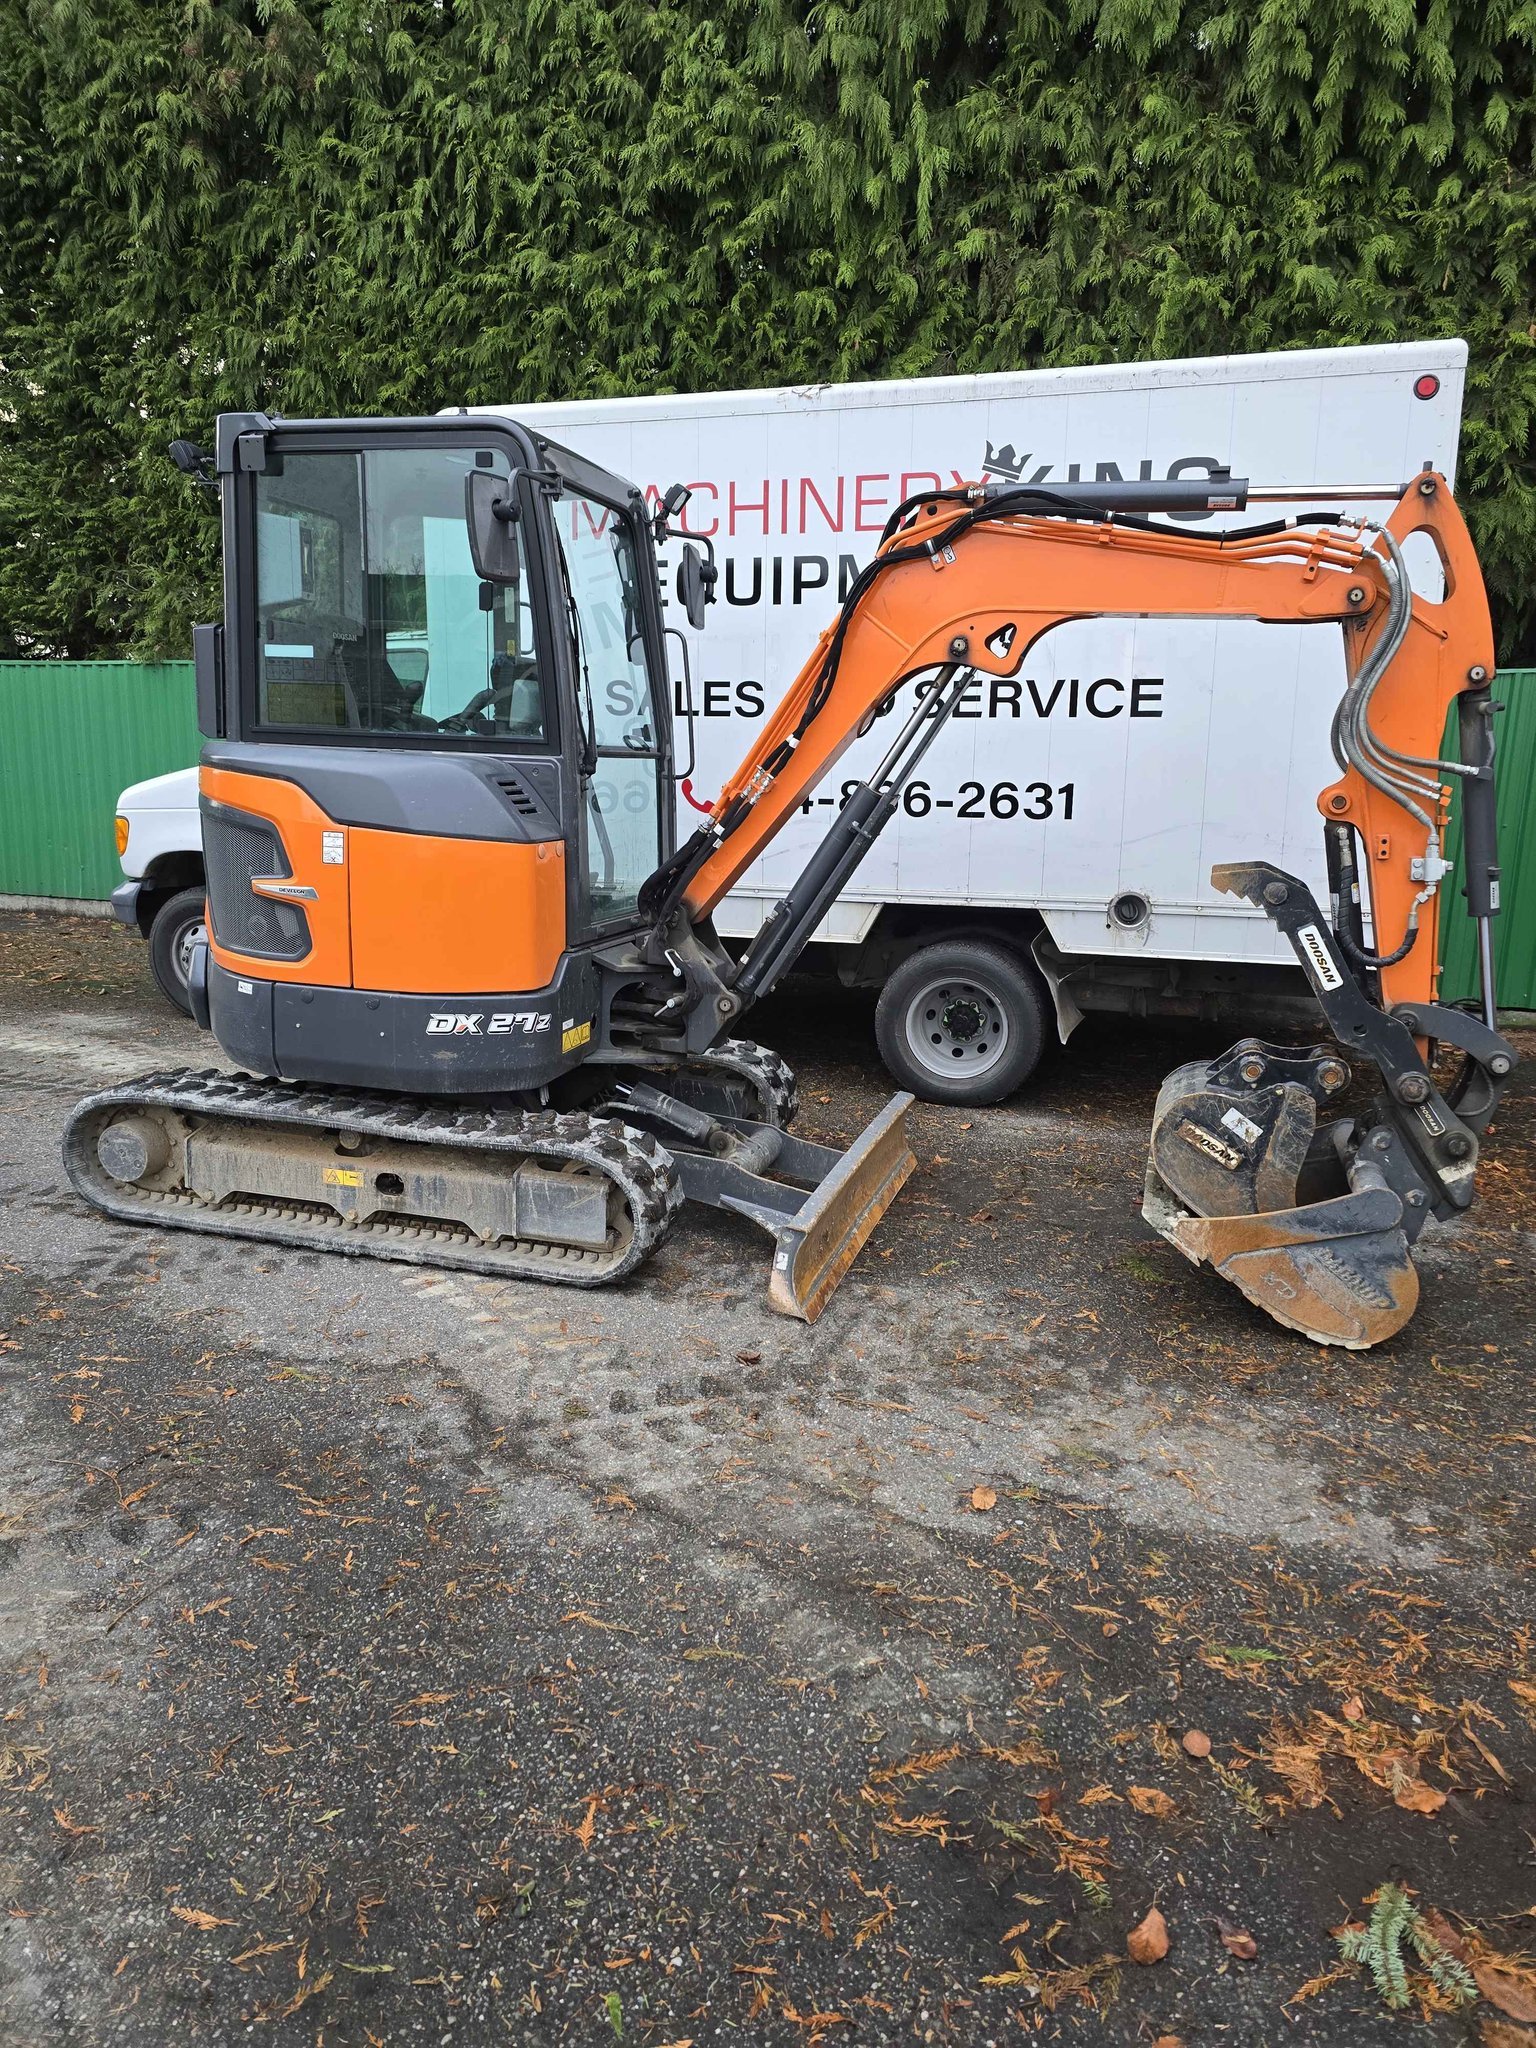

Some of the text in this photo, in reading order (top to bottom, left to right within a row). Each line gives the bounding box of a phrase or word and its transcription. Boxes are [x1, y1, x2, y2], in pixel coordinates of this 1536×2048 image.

[912, 678, 1165, 719] SERVICE
[1304, 932, 1337, 984] DOOSAN
[426, 1013, 485, 1035] DX
[1418, 1103, 1441, 1132] DOOSAN
